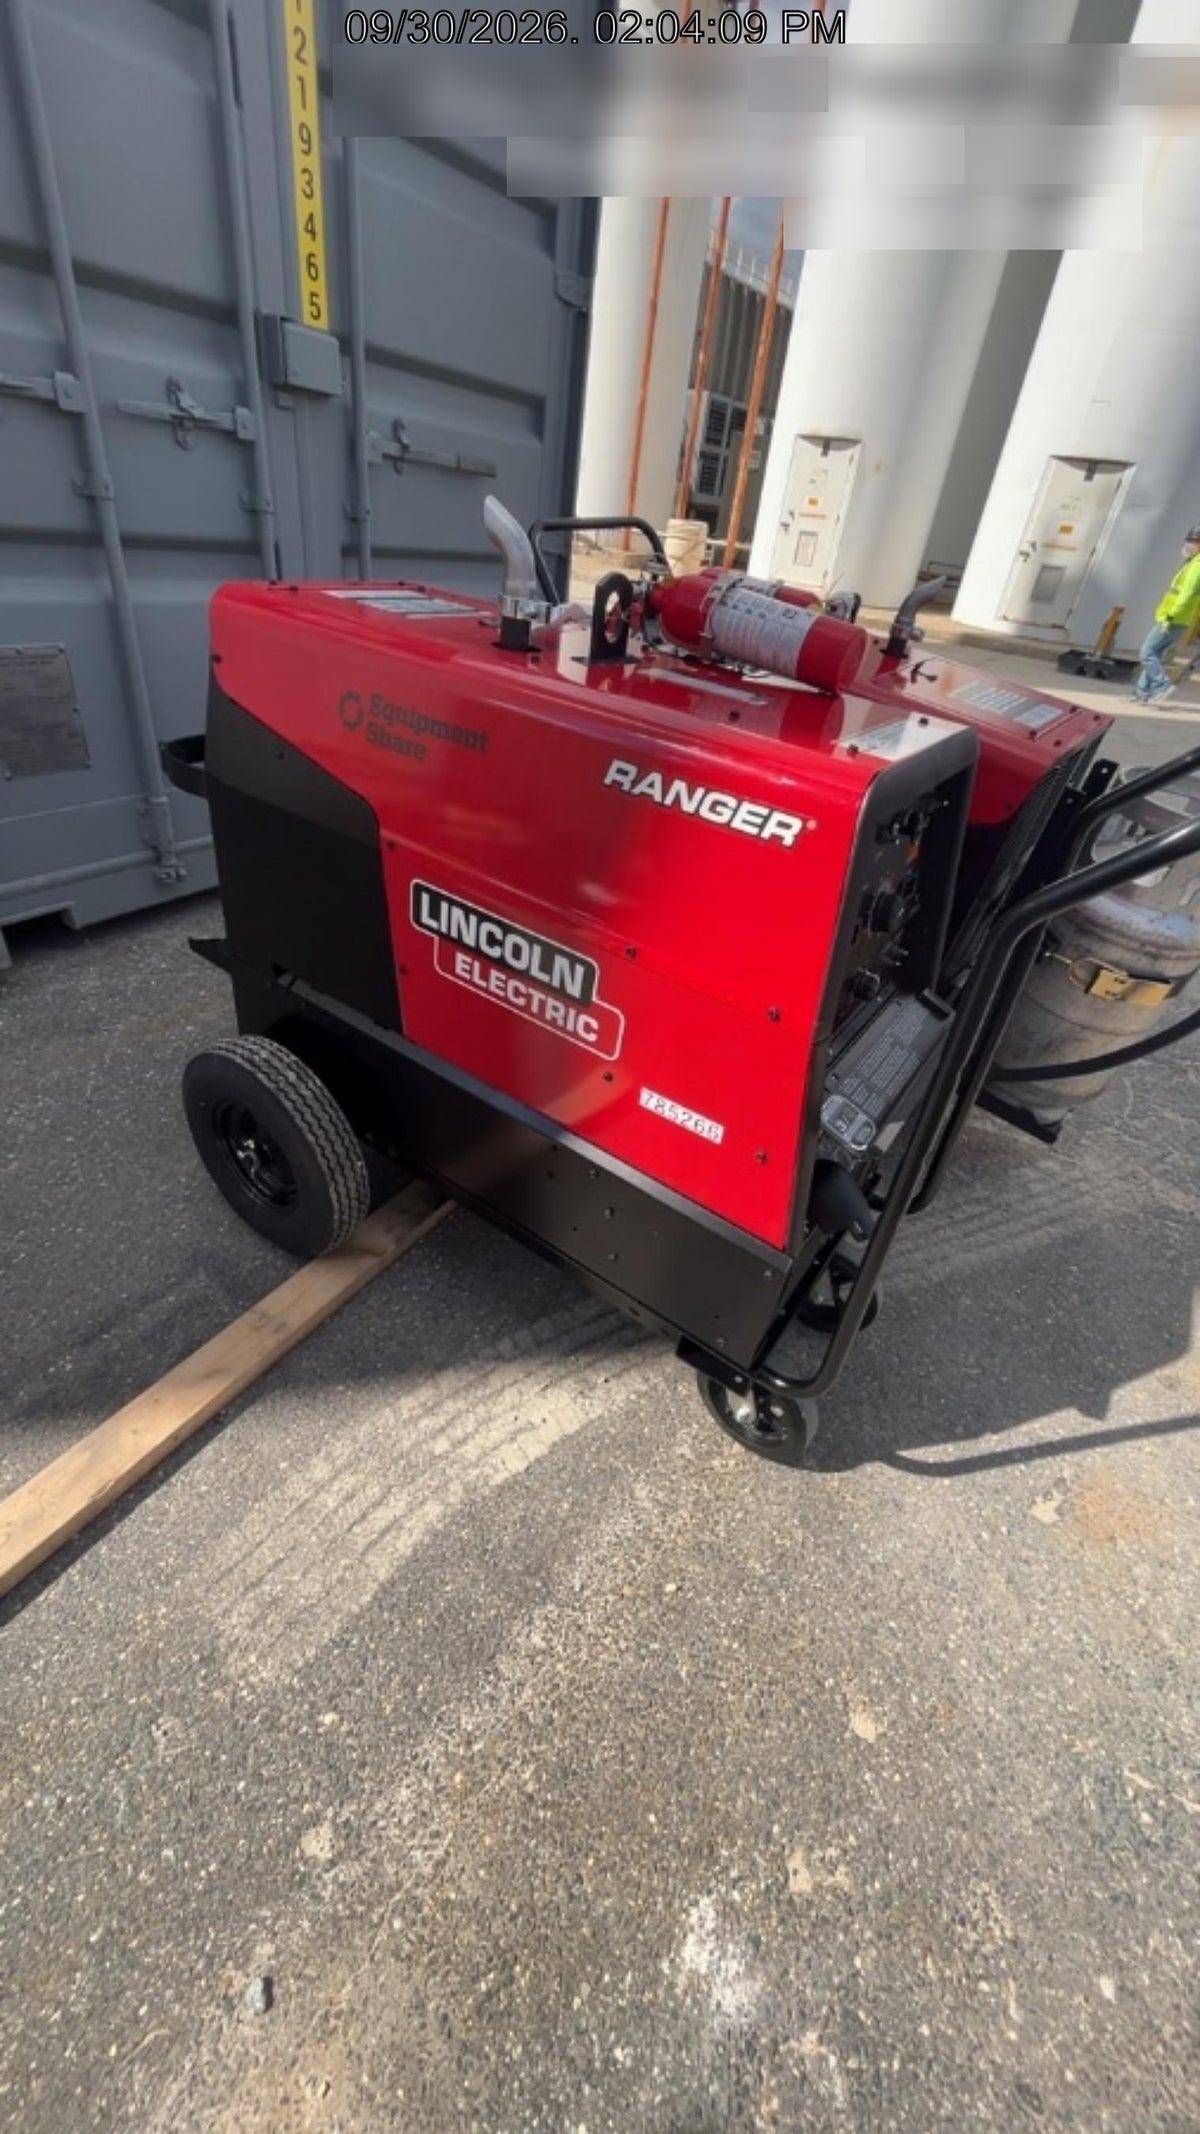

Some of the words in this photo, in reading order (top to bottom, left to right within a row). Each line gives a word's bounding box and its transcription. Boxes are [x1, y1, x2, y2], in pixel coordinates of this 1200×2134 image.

[366, 721, 426, 763] Share
[370, 692, 488, 752] Equipment
[604, 758, 803, 847] RANGER
[420, 891, 584, 999] LINCOLN
[455, 952, 599, 1043] ELECTRIC
